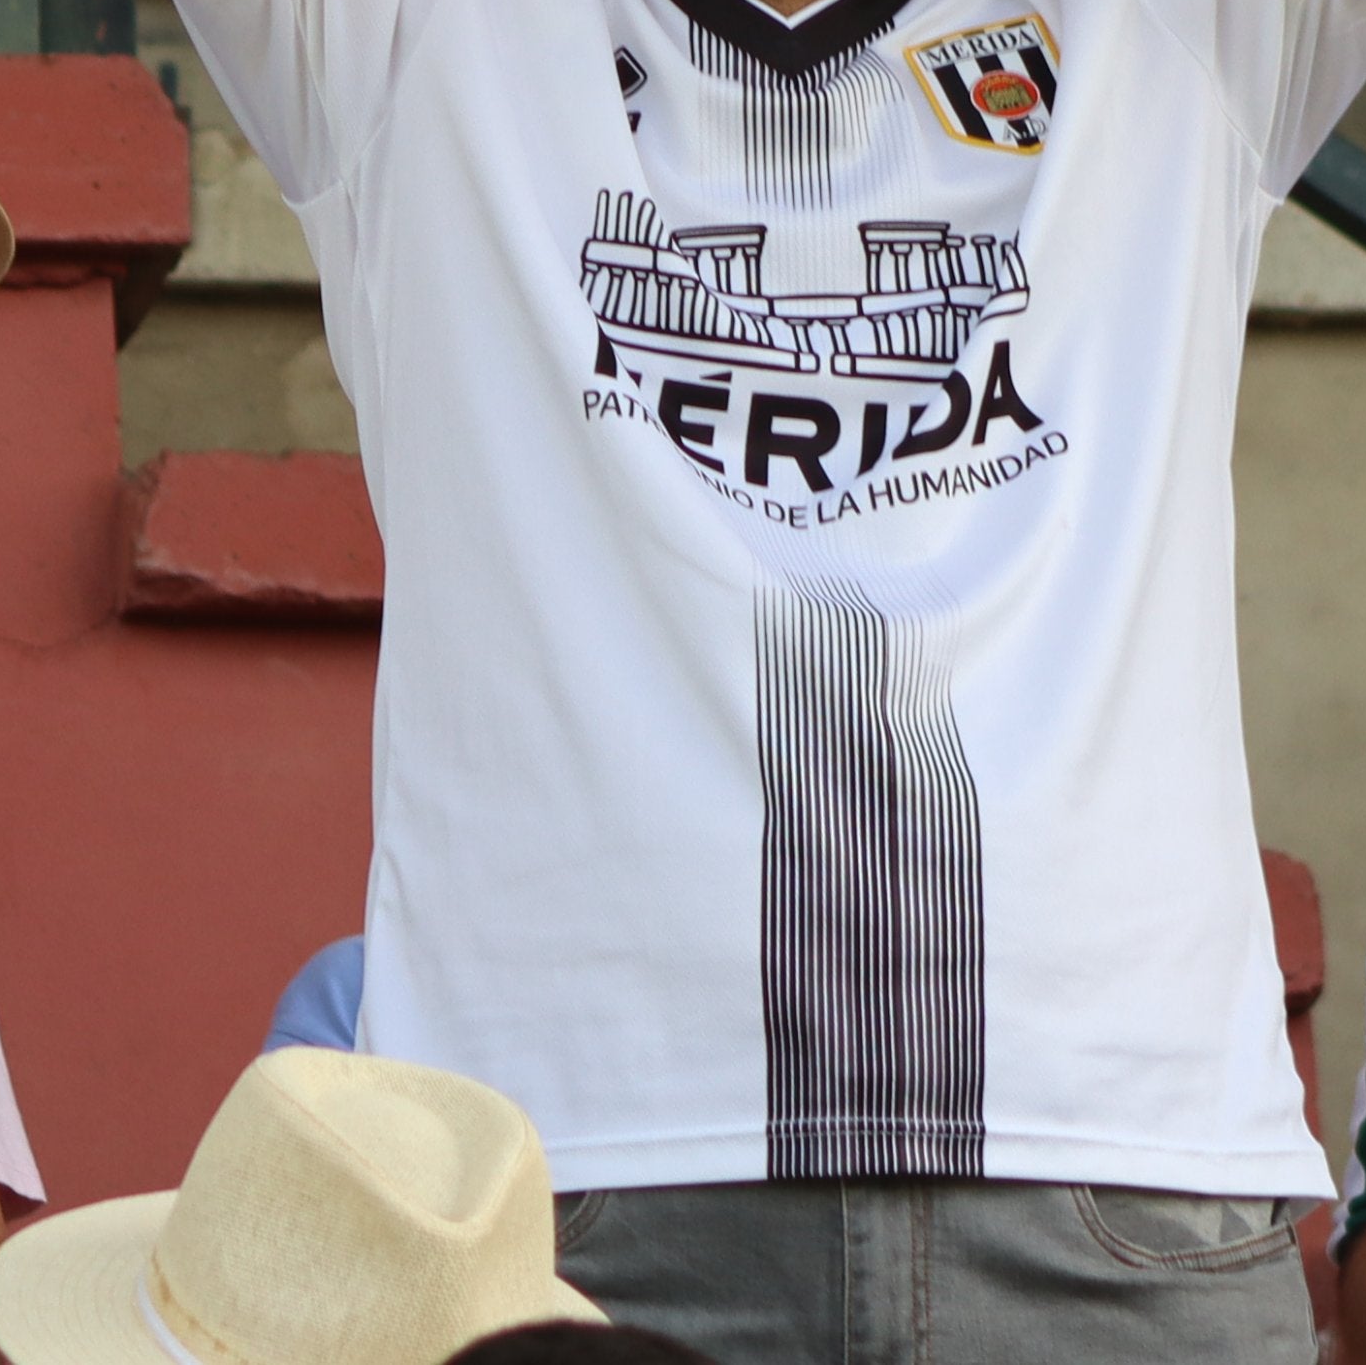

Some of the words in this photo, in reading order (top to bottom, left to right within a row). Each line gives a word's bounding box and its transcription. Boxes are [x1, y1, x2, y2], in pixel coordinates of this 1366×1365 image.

[763, 498, 808, 530] DE
[816, 490, 861, 525] LA
[867, 430, 1070, 512] HUMANIDAD
